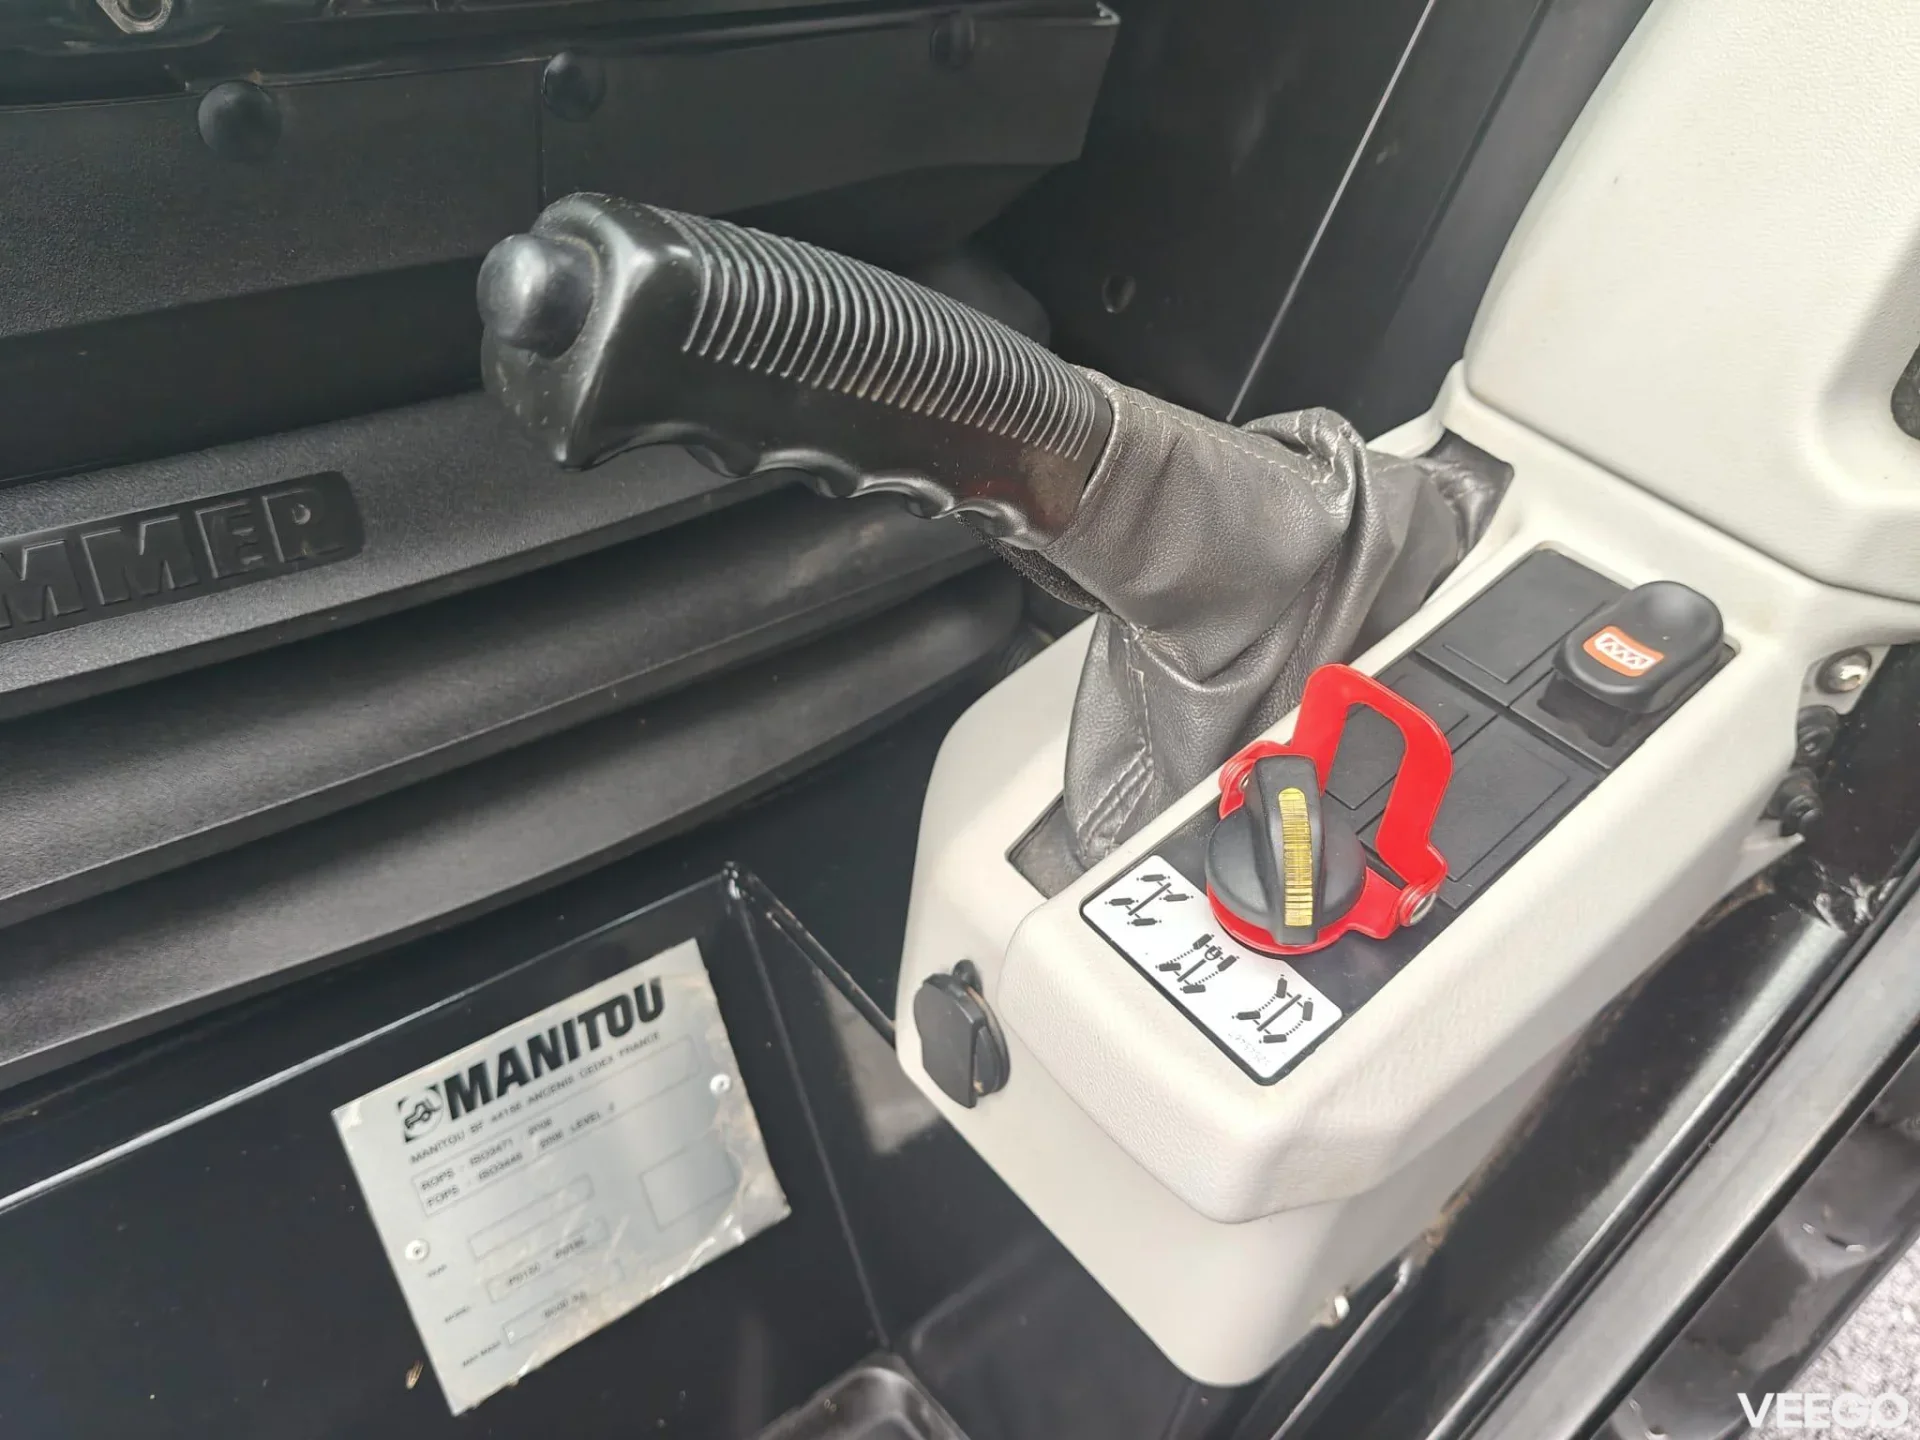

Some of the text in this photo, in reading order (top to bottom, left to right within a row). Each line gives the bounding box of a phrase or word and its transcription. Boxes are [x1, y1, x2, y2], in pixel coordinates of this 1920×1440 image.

[410, 1130, 465, 1164] MANITOU
[618, 1031, 660, 1057] FRANCE
[444, 975, 665, 1120] MANITOU
